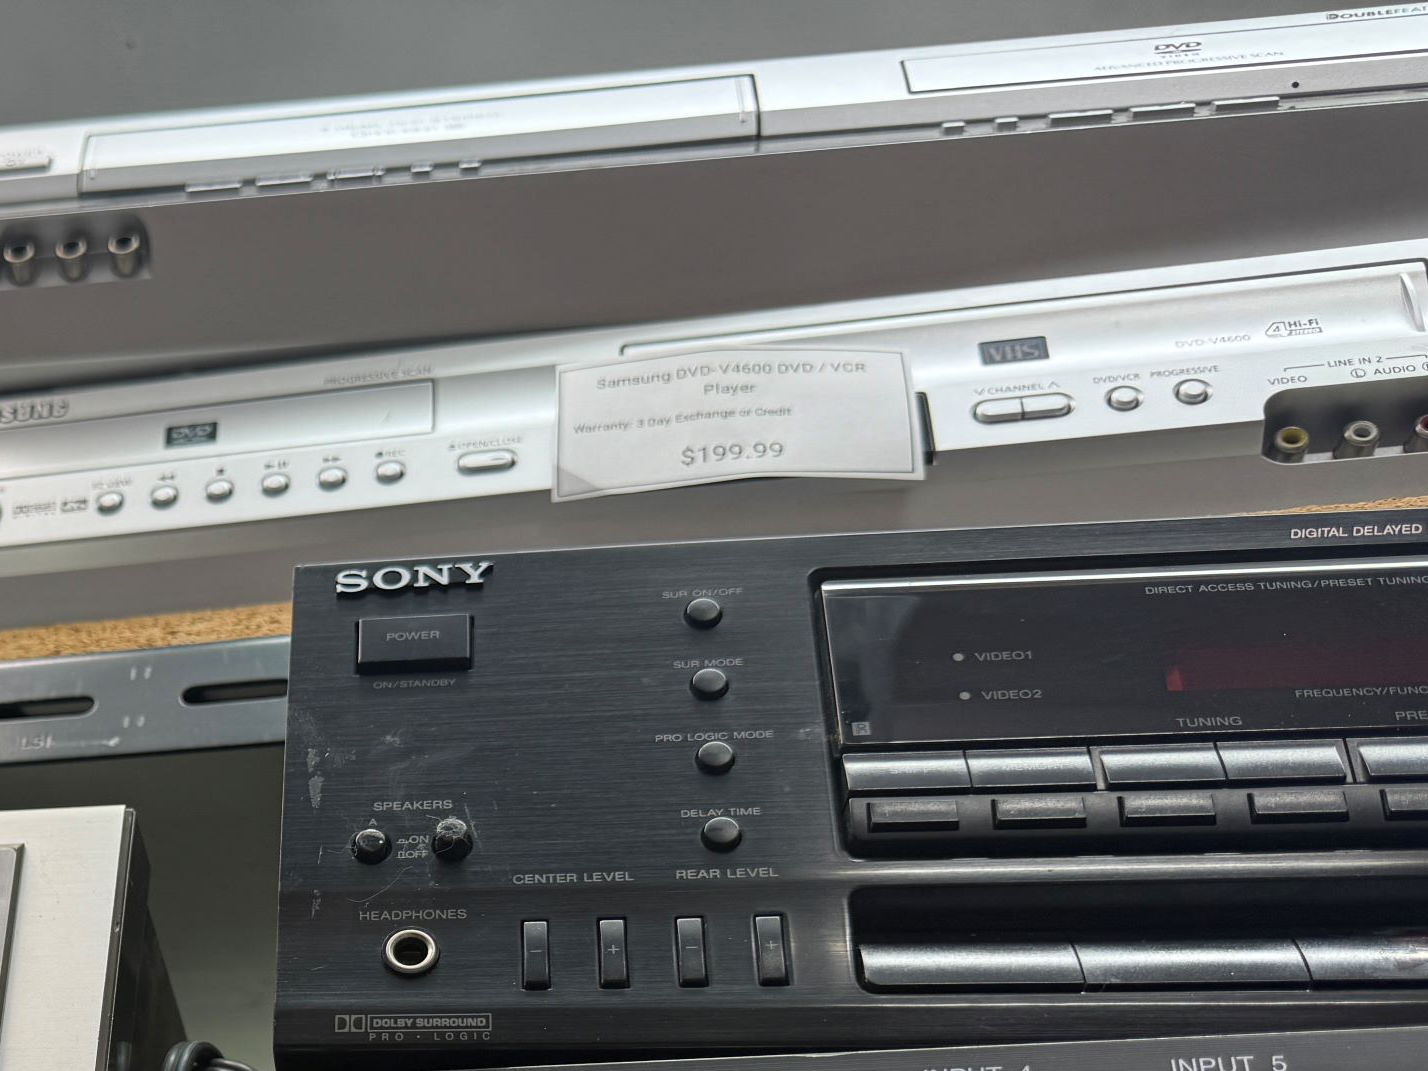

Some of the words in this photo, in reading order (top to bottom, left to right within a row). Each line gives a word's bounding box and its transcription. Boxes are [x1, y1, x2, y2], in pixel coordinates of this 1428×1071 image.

[1167, 54, 1248, 67] PROGRESSIVE
[1250, 50, 1285, 60] SCAN
[986, 340, 1042, 362] VHS
[1327, 358, 1355, 369] LINE
[1358, 356, 1372, 366] IN
[1376, 355, 1384, 364] 2
[595, 370, 672, 390] Samsung
[676, 362, 774, 381] DVD-V4600
[777, 362, 814, 374] DVD
[832, 362, 867, 374] VCR
[1373, 364, 1417, 376] AUDIO
[1092, 373, 1141, 385] DVD/VCR
[1267, 374, 1308, 386] VIDEO
[703, 383, 758, 397] Player
[987, 381, 1046, 396] CHANNEL
[572, 421, 634, 435] Warranty:
[636, 419, 645, 429] 3
[647, 417, 673, 430] Day
[674, 408, 737, 424] Exchange
[739, 410, 752, 418] or
[754, 407, 792, 418] Credit
[681, 441, 785, 467] $199.99
[1290, 526, 1348, 540] DIGITAL
[1353, 523, 1423, 537] DELAYED
[335, 562, 494, 596] SONY
[1144, 584, 1196, 596] DIRECT
[1198, 581, 1255, 593] ACCESS
[1256, 577, 1373, 592] TUNING/PRESET
[661, 590, 688, 601] SUR
[690, 587, 744, 600] ON/OFF
[386, 630, 440, 642] POWER
[673, 659, 700, 670] SUR
[703, 656, 744, 668] MODE
[974, 650, 1033, 663] VIDEO1
[372, 677, 457, 690] ON/STANDBY
[981, 688, 1043, 701] VIDEO2
[1175, 716, 1243, 729] TUNING
[654, 733, 683, 744] PRO
[686, 731, 729, 742] LOGIC
[732, 729, 774, 740] MODE
[373, 800, 453, 812] SPEAKERS
[680, 808, 724, 819] DELAY
[728, 806, 761, 818] TIME
[512, 872, 578, 885] CENTER
[582, 870, 635, 883] LEVEL
[675, 868, 723, 881] REAR
[726, 866, 780, 879] LEVEL
[359, 909, 468, 922] HEADPHONES
[372, 1016, 414, 1029] DOLBY
[416, 1015, 487, 1028] SURROUND
[368, 1033, 404, 1042] PRO
[433, 1031, 492, 1042] LOGIC
